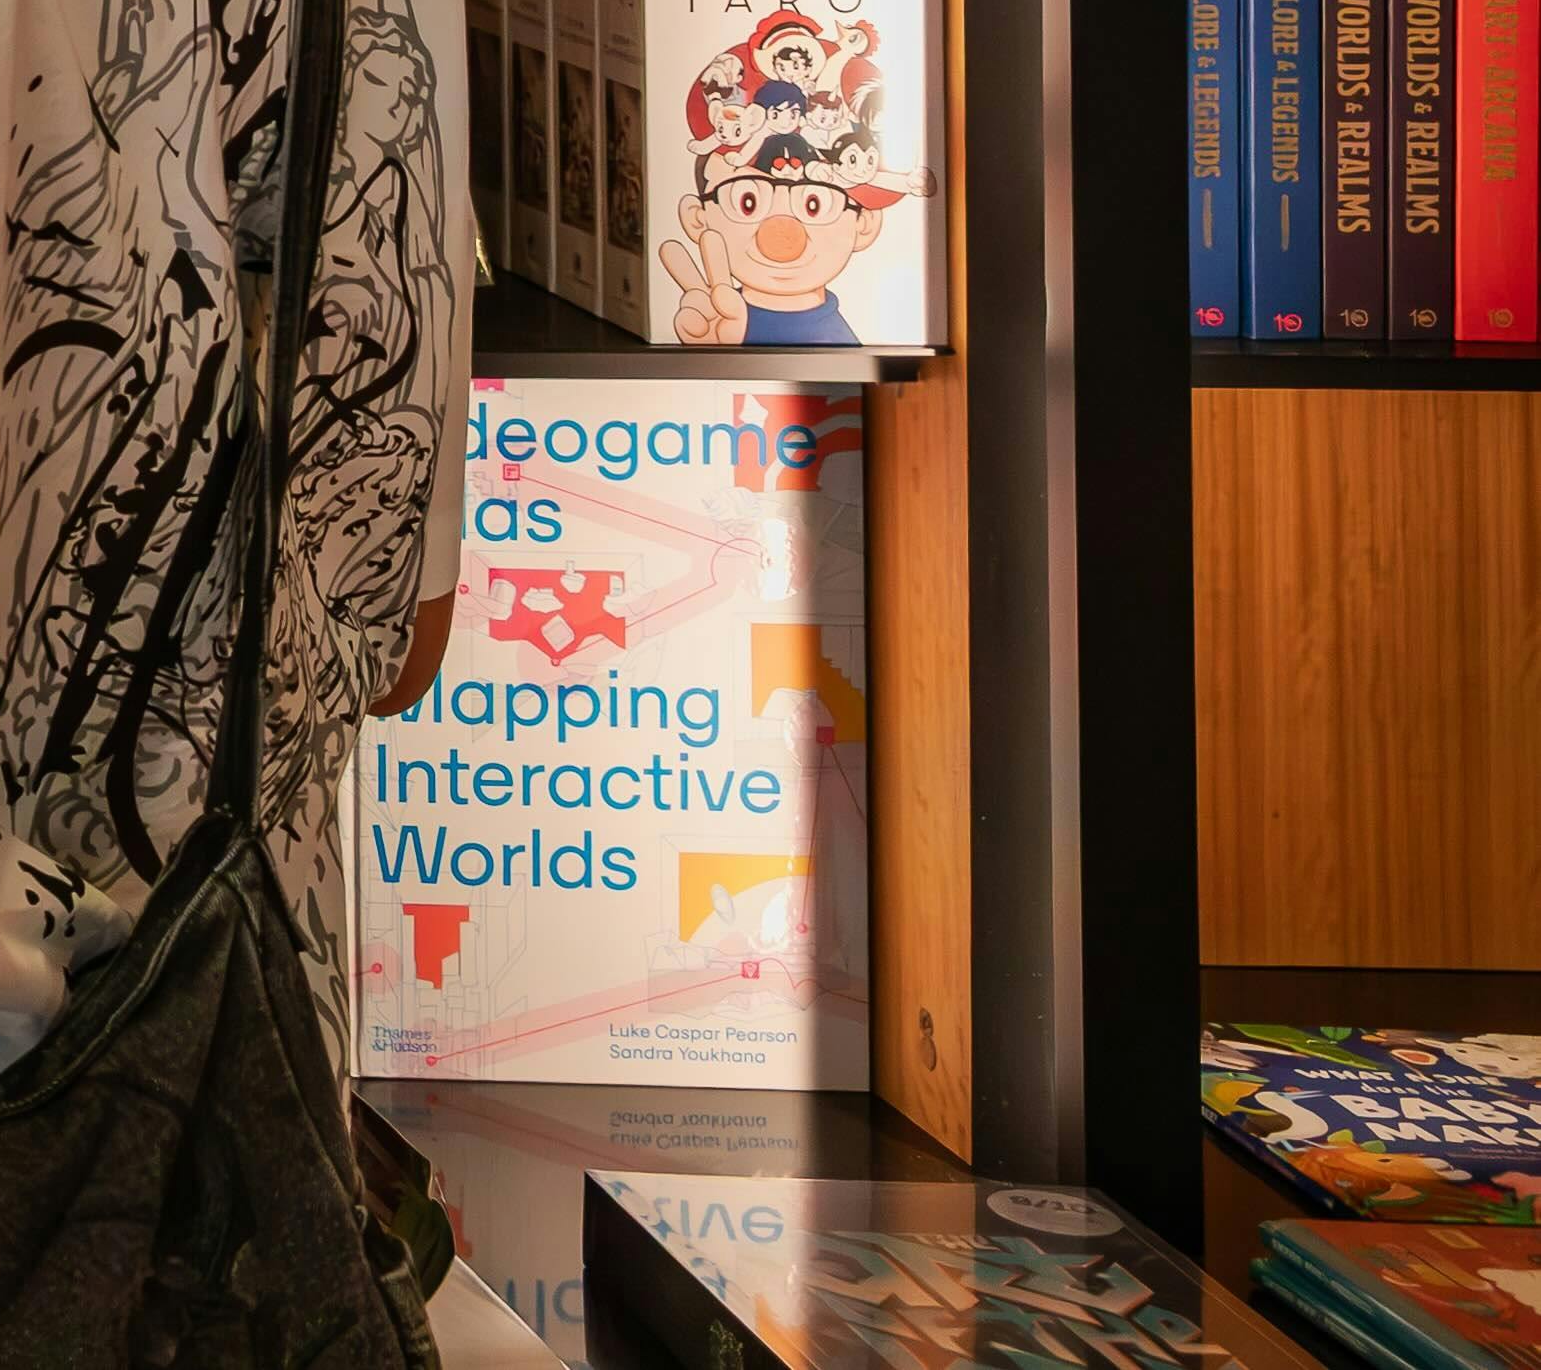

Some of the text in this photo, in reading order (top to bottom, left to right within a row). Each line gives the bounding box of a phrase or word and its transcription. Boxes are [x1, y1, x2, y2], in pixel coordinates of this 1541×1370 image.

[1344, 101, 1362, 114] &
[1337, 121, 1370, 235] REALMS
[375, 743, 783, 815] Interactive
[372, 824, 639, 892] Worlds
[609, 1023, 798, 1044] Luke Caspar Pearson
[609, 1045, 766, 1064] Sandra Youkhana
